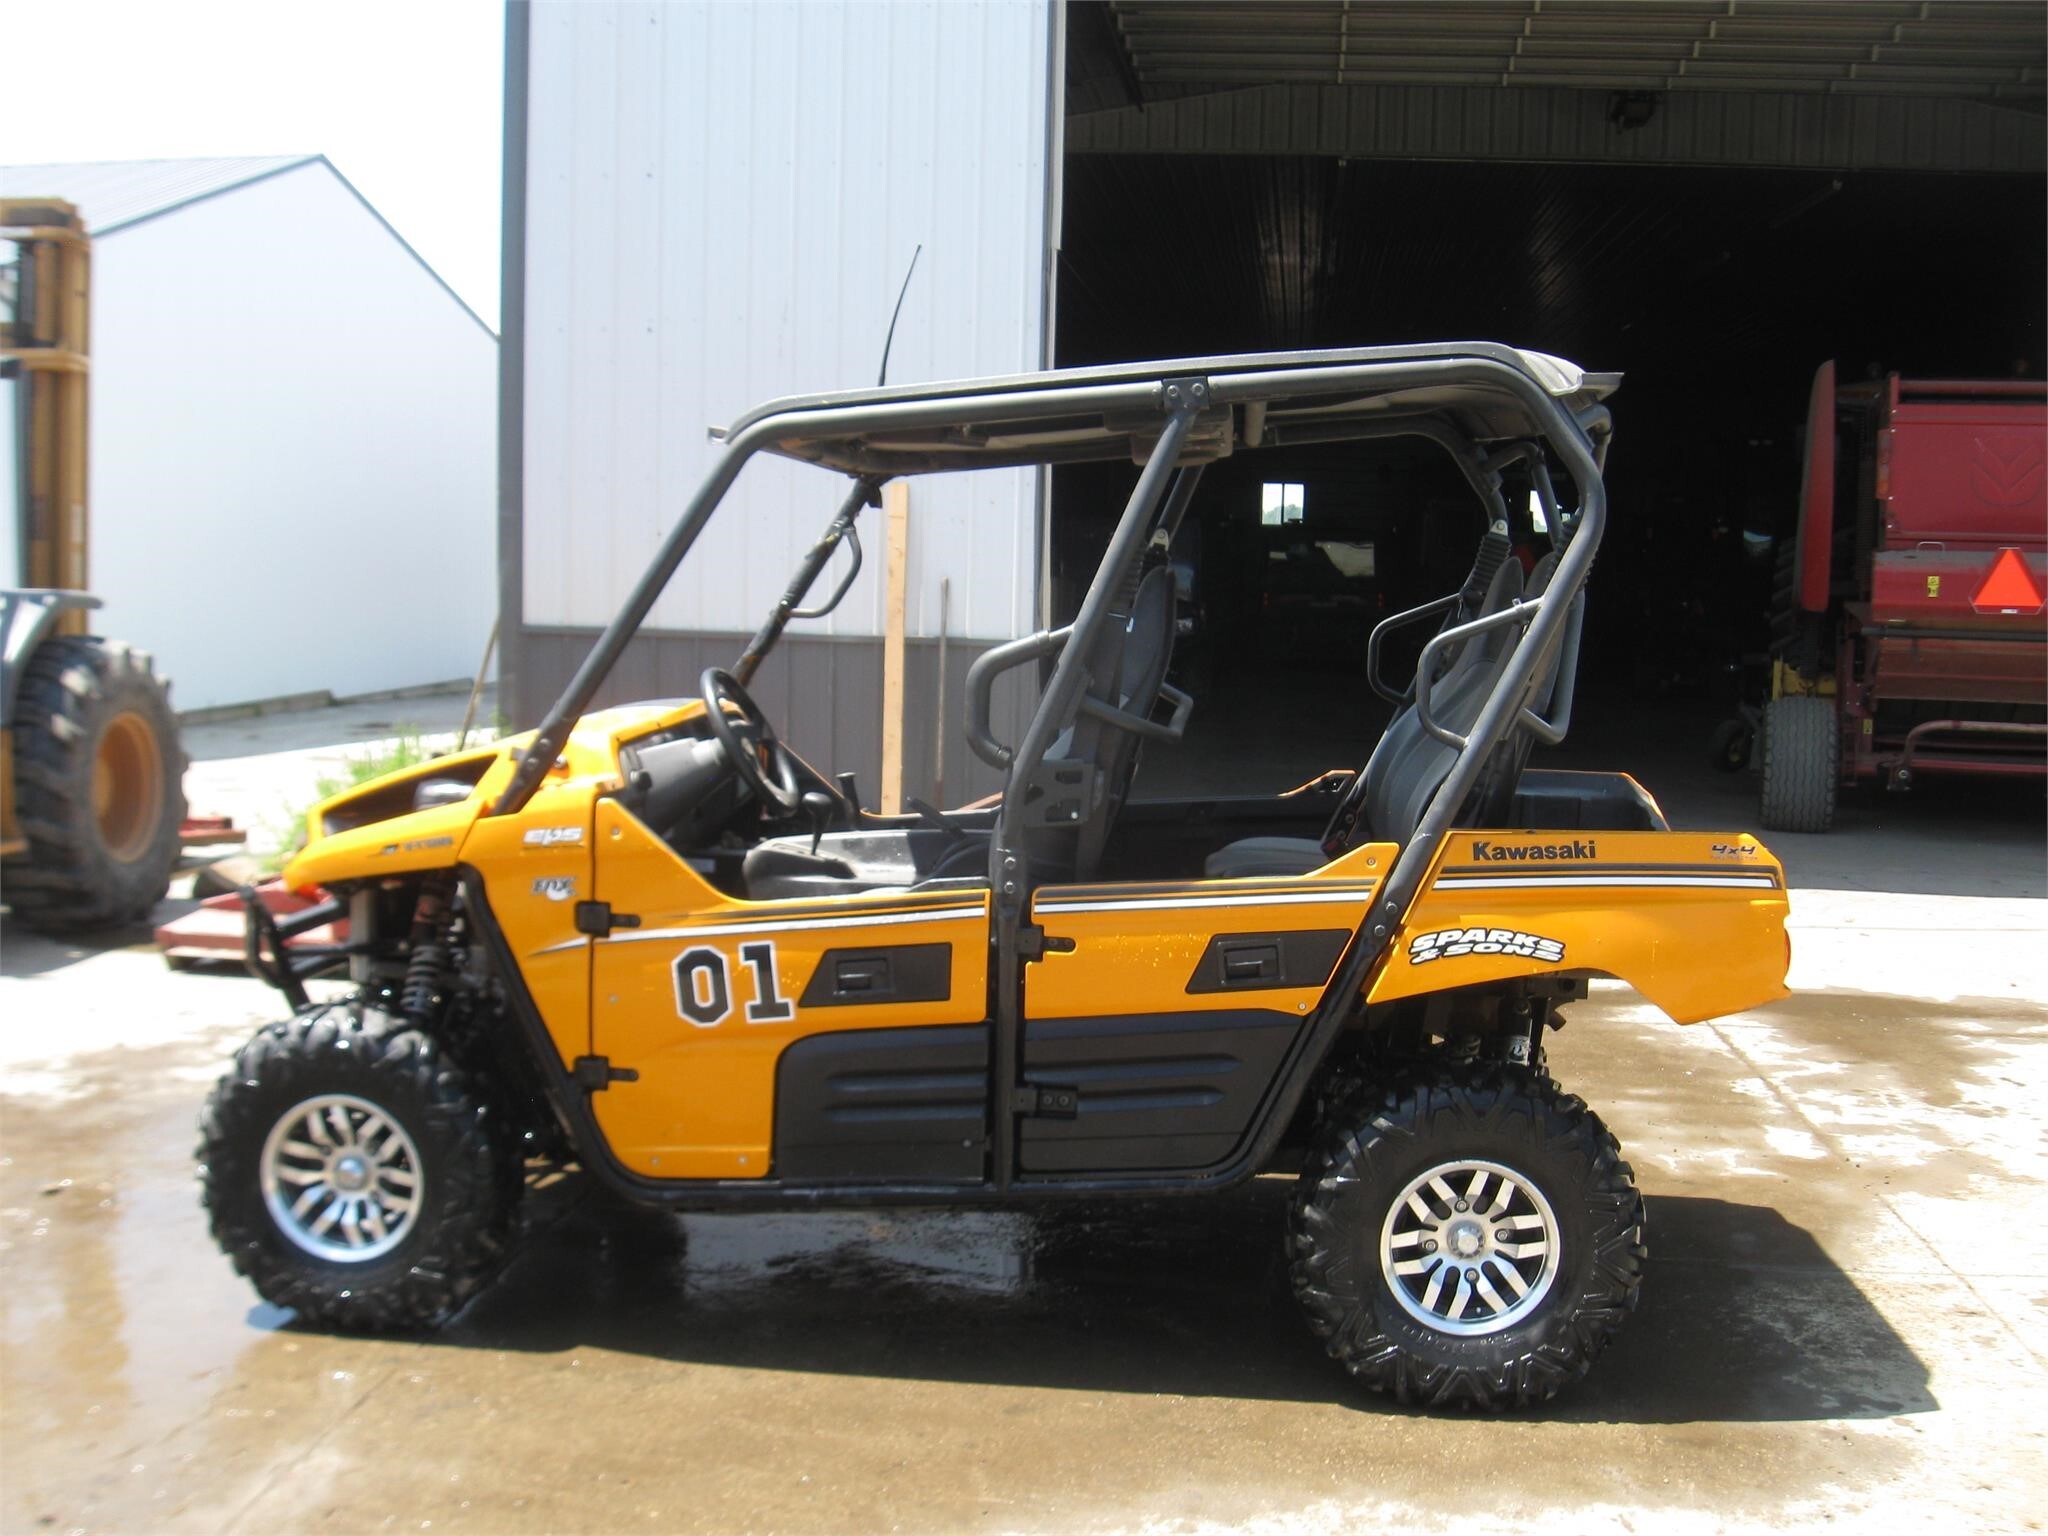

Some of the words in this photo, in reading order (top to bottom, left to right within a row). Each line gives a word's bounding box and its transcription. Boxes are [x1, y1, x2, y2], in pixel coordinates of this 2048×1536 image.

[1472, 840, 1596, 861] Kawasaki
[1409, 927, 1566, 954] SPARKS
[1409, 946, 1441, 965] &
[1443, 942, 1565, 963] SONS
[671, 940, 795, 1028] 01
